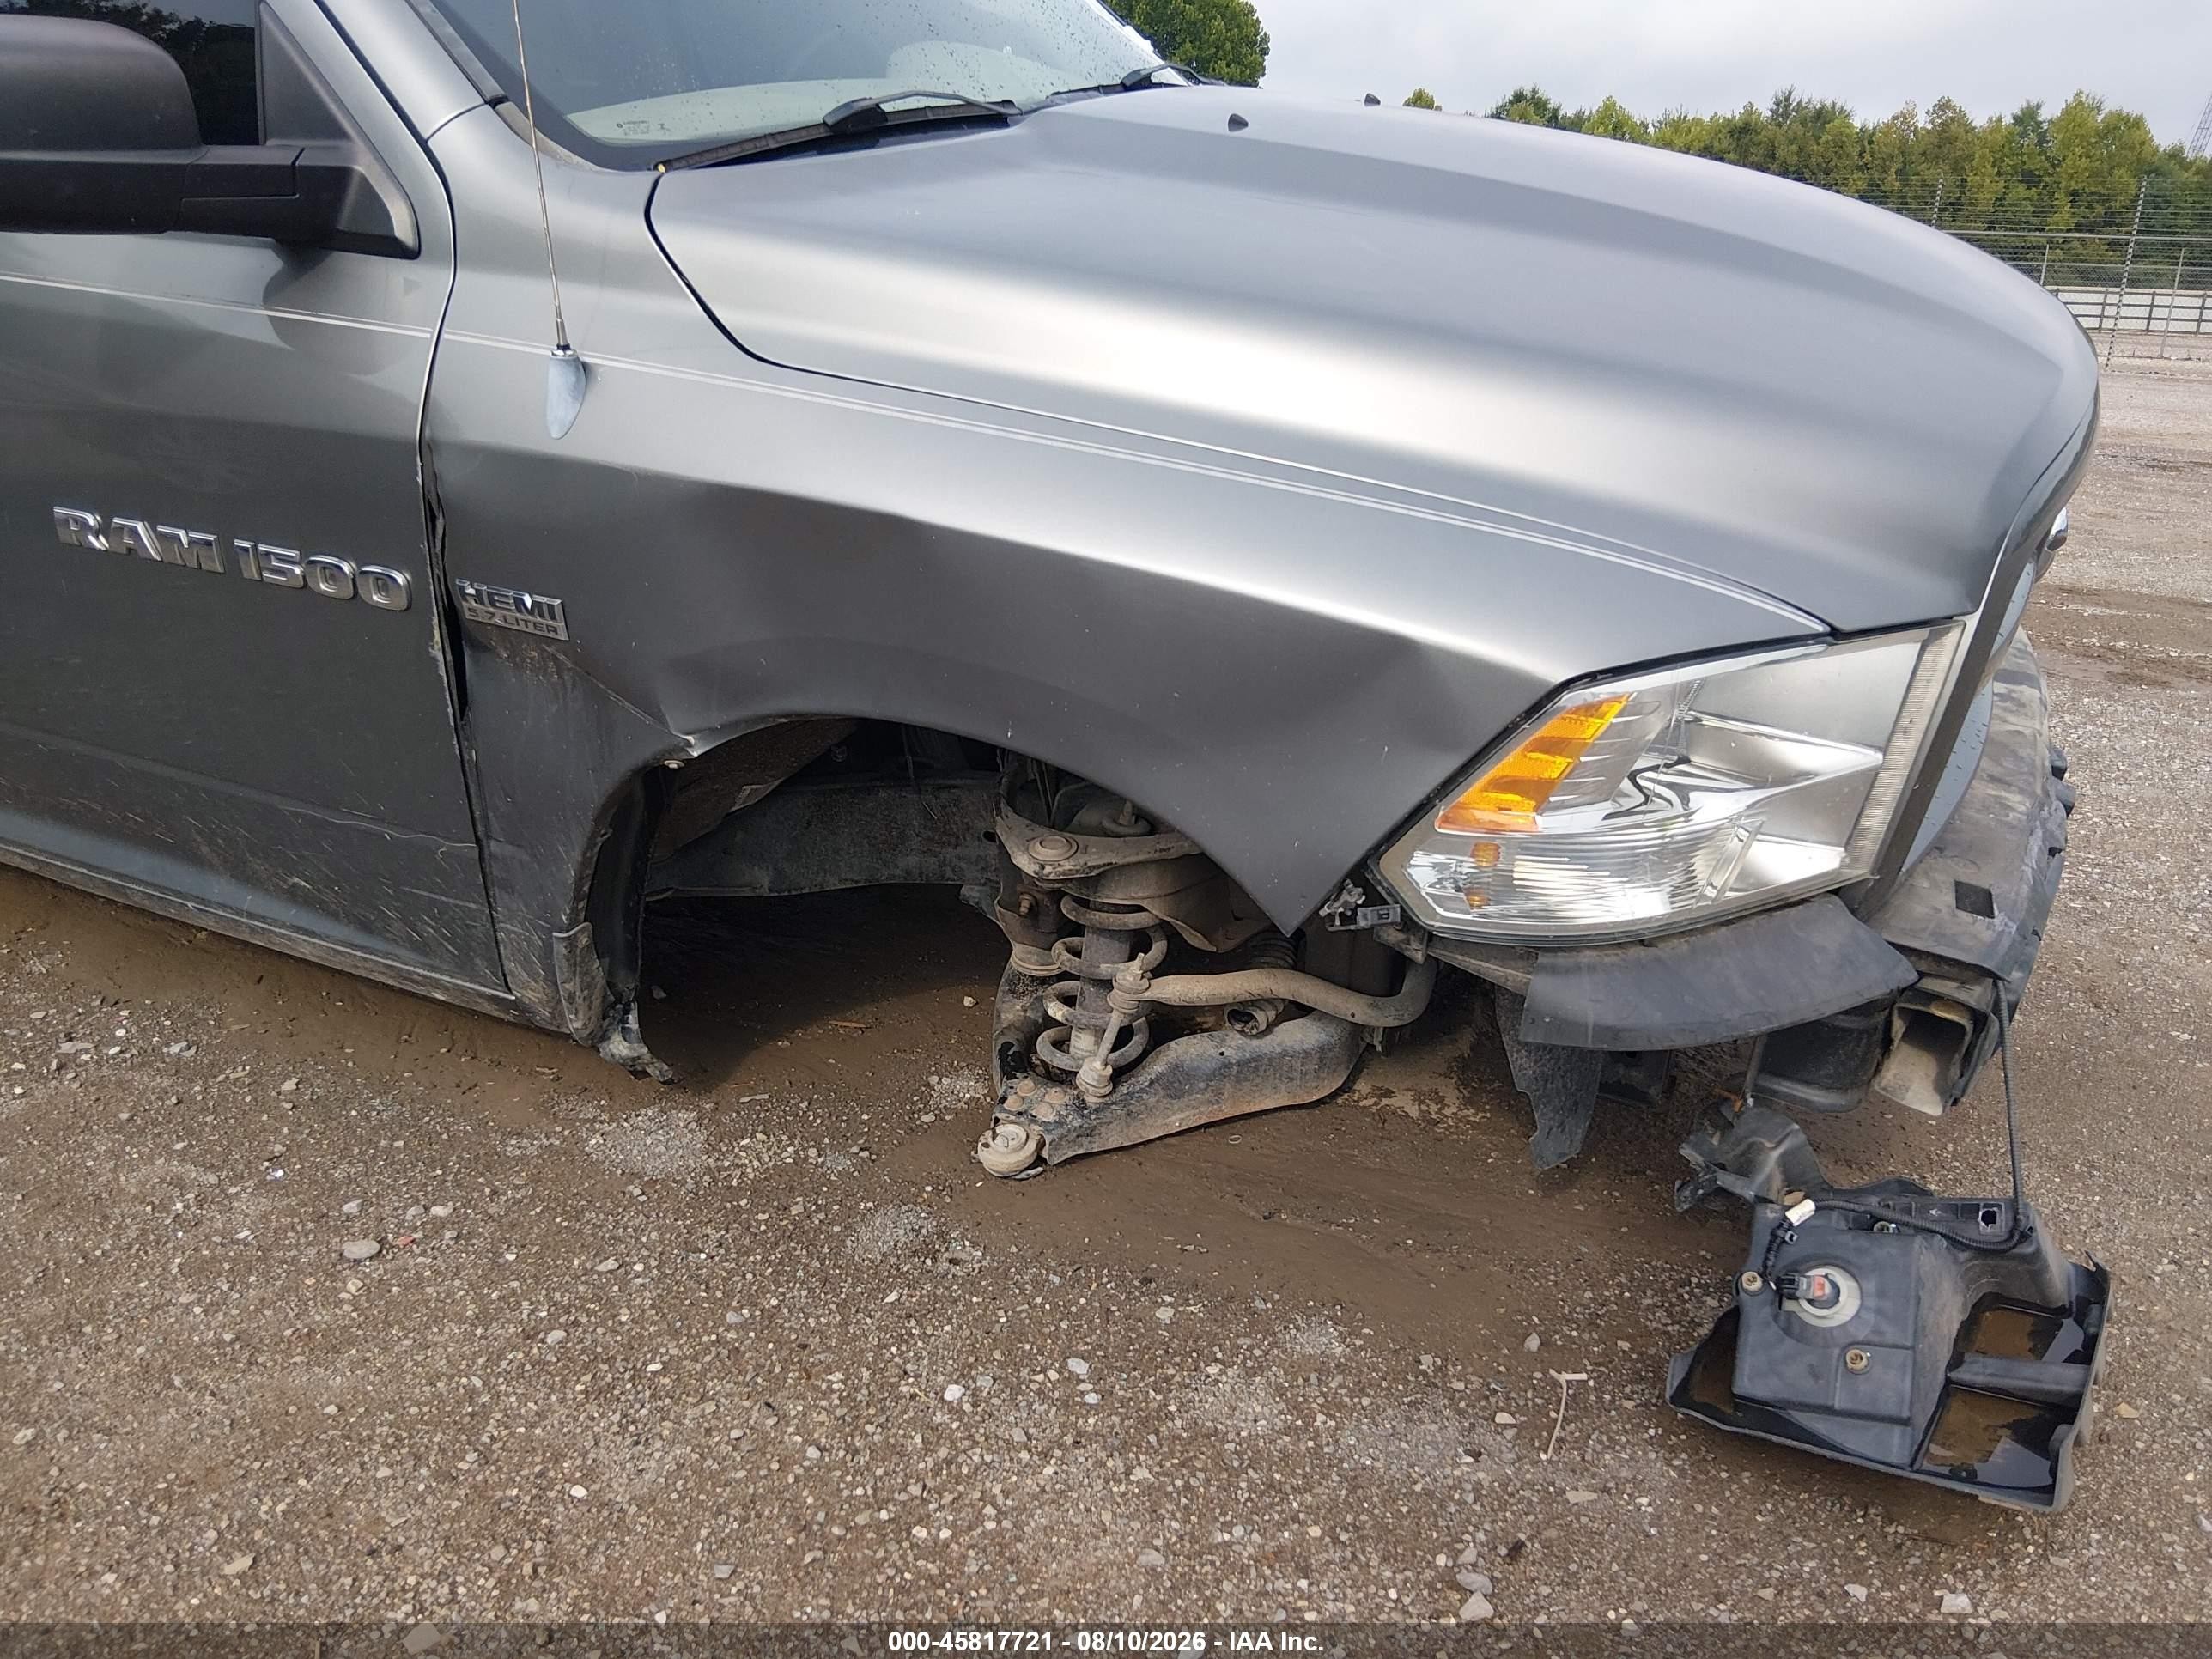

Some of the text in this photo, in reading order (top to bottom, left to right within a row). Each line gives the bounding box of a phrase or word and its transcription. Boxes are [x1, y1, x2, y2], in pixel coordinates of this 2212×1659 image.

[52, 506, 413, 612] RAM 1500
[456, 578, 564, 624] HEMI
[503, 615, 559, 635] LITER
